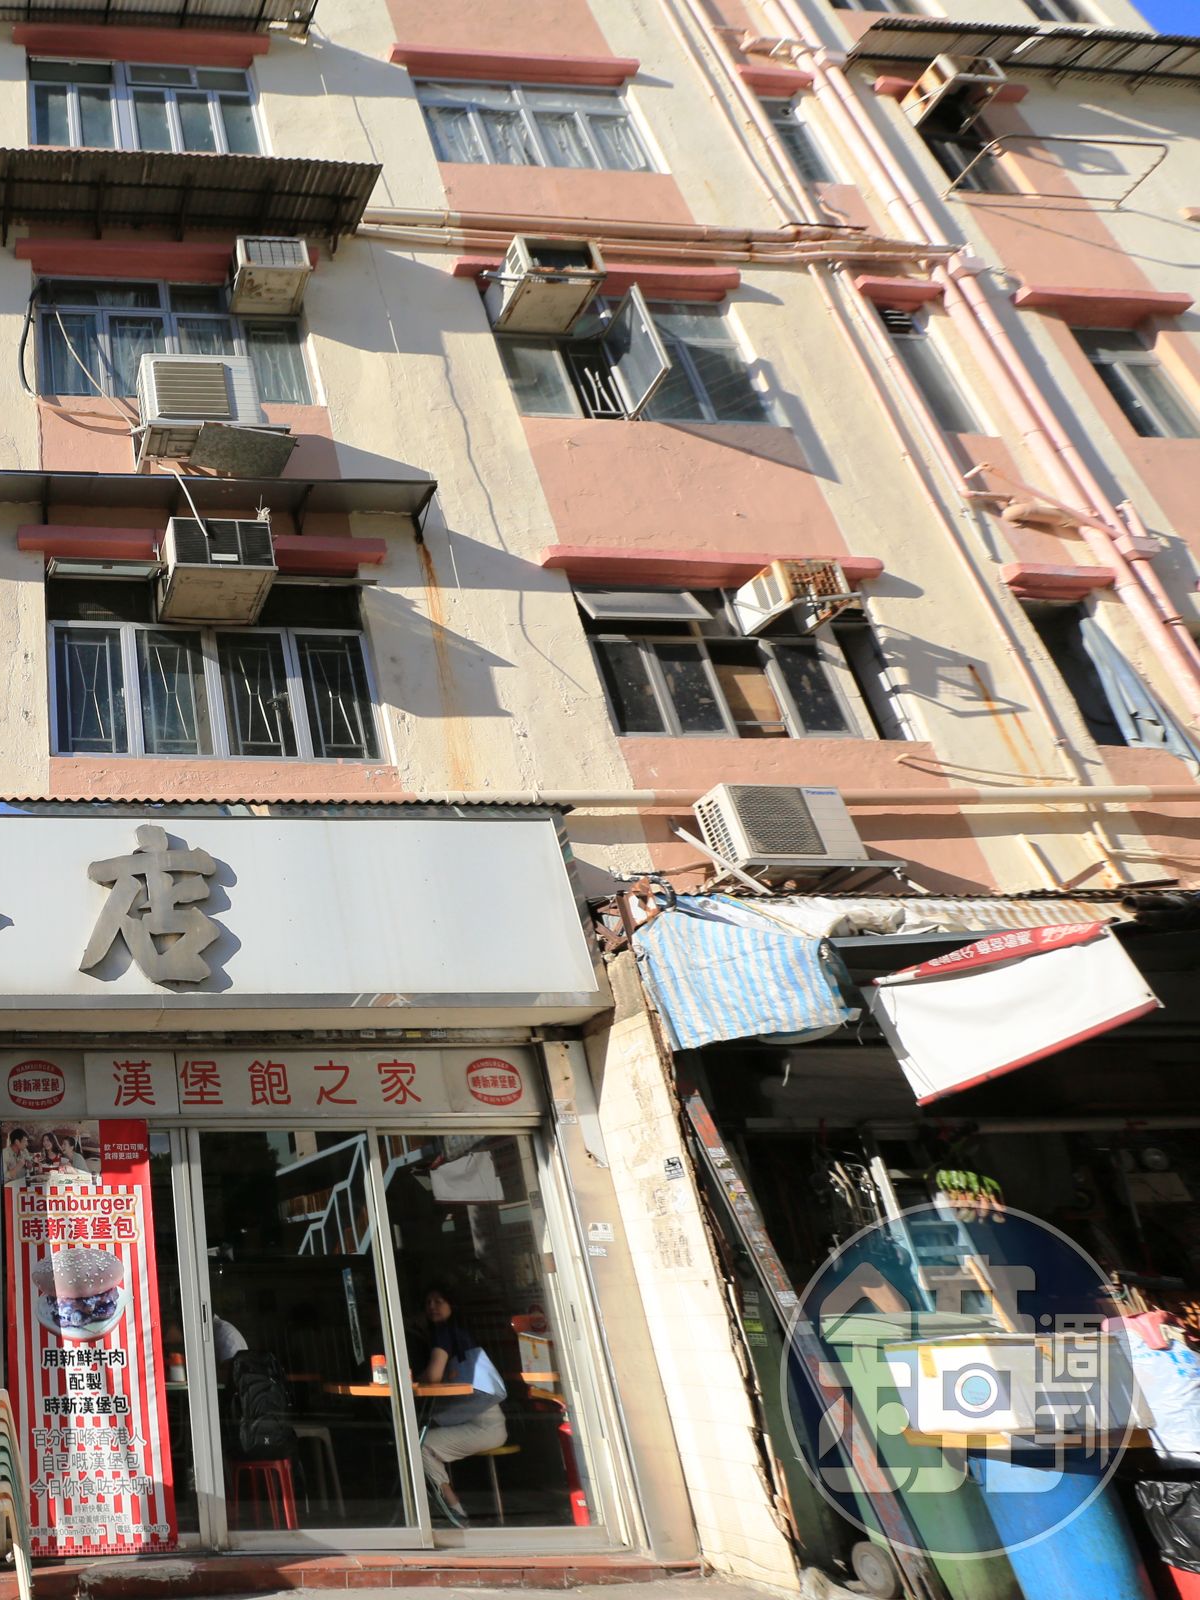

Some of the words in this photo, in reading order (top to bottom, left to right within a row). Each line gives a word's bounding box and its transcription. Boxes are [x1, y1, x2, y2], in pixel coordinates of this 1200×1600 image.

[13, 1077, 61, 1093] 時新漢堡飽
[112, 1059, 423, 1106] 漢堡飽之家
[19, 1195, 135, 1215] Hamburger
[21, 1216, 136, 1241] 時新漢堡包
[43, 1349, 125, 1367] 用新鮮牛肉
[69, 1372, 102, 1391] 配製
[44, 1396, 129, 1415] 時新漢堡包
[42, 1452, 141, 1472] 自己嘅漢堡包
[31, 1476, 153, 1498] 今日你食咗未呀!
[74, 1503, 111, 1513] 時新快餐店
